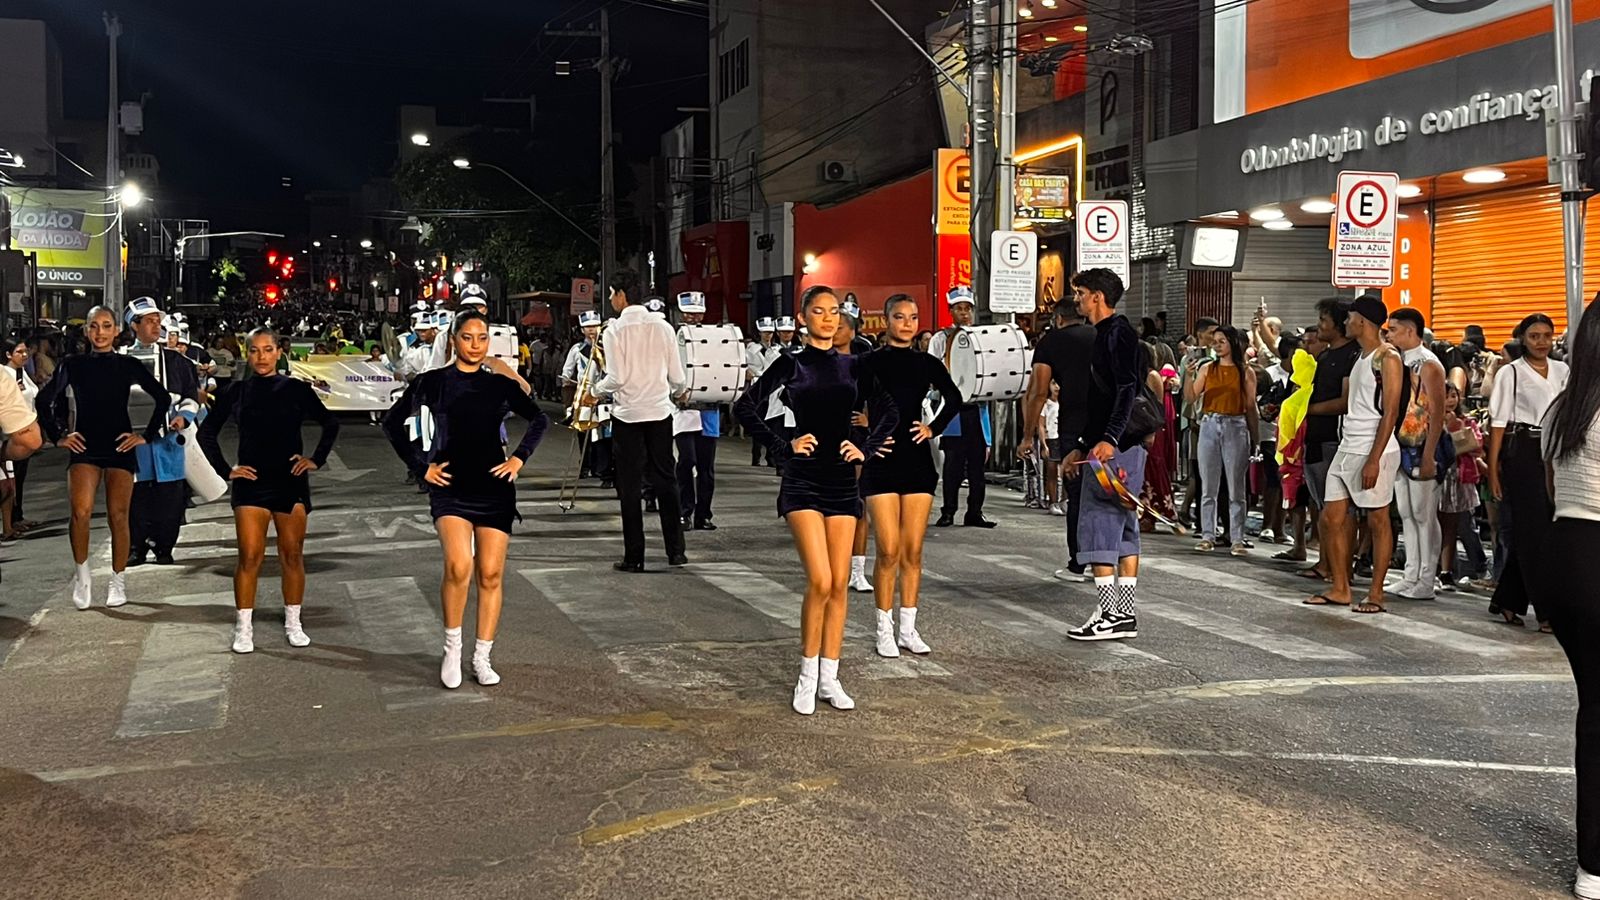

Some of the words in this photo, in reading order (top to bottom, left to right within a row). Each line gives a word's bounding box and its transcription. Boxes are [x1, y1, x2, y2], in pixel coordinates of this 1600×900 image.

[1240, 126, 1364, 174] Odontologia
[1375, 116, 1407, 146] de
[1420, 85, 1558, 135] confiança
[1360, 193, 1373, 216] E
[14, 210, 73, 228] LOJÃO
[1097, 215, 1107, 233] E
[23, 235, 36, 243] DA
[41, 234, 82, 246] MODA
[1010, 244, 1019, 260] E
[49, 269, 82, 280] ÚNICO
[1400, 238, 1410, 305] DEN
[580, 284, 586, 292] E
